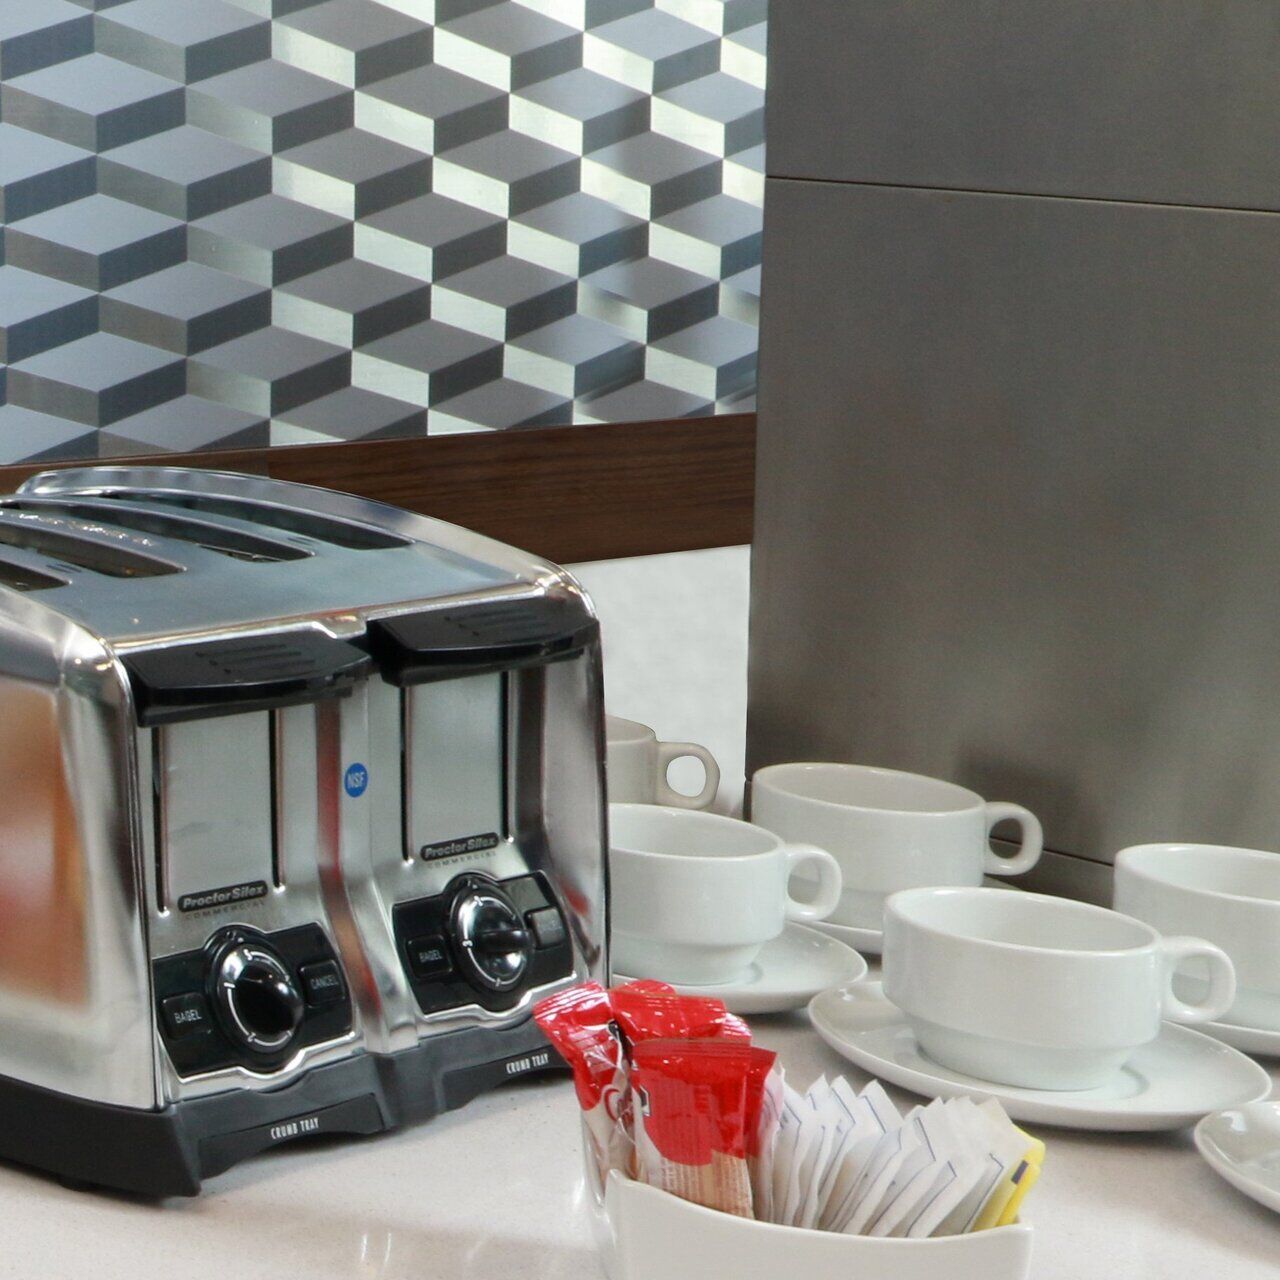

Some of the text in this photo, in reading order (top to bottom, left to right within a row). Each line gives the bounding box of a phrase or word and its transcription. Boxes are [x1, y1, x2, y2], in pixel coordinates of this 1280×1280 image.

[174, 1010, 202, 1024] BAGEL
[506, 1053, 549, 1074] CRUMB TRAY
[270, 1117, 320, 1139] CRUMB TRAY
